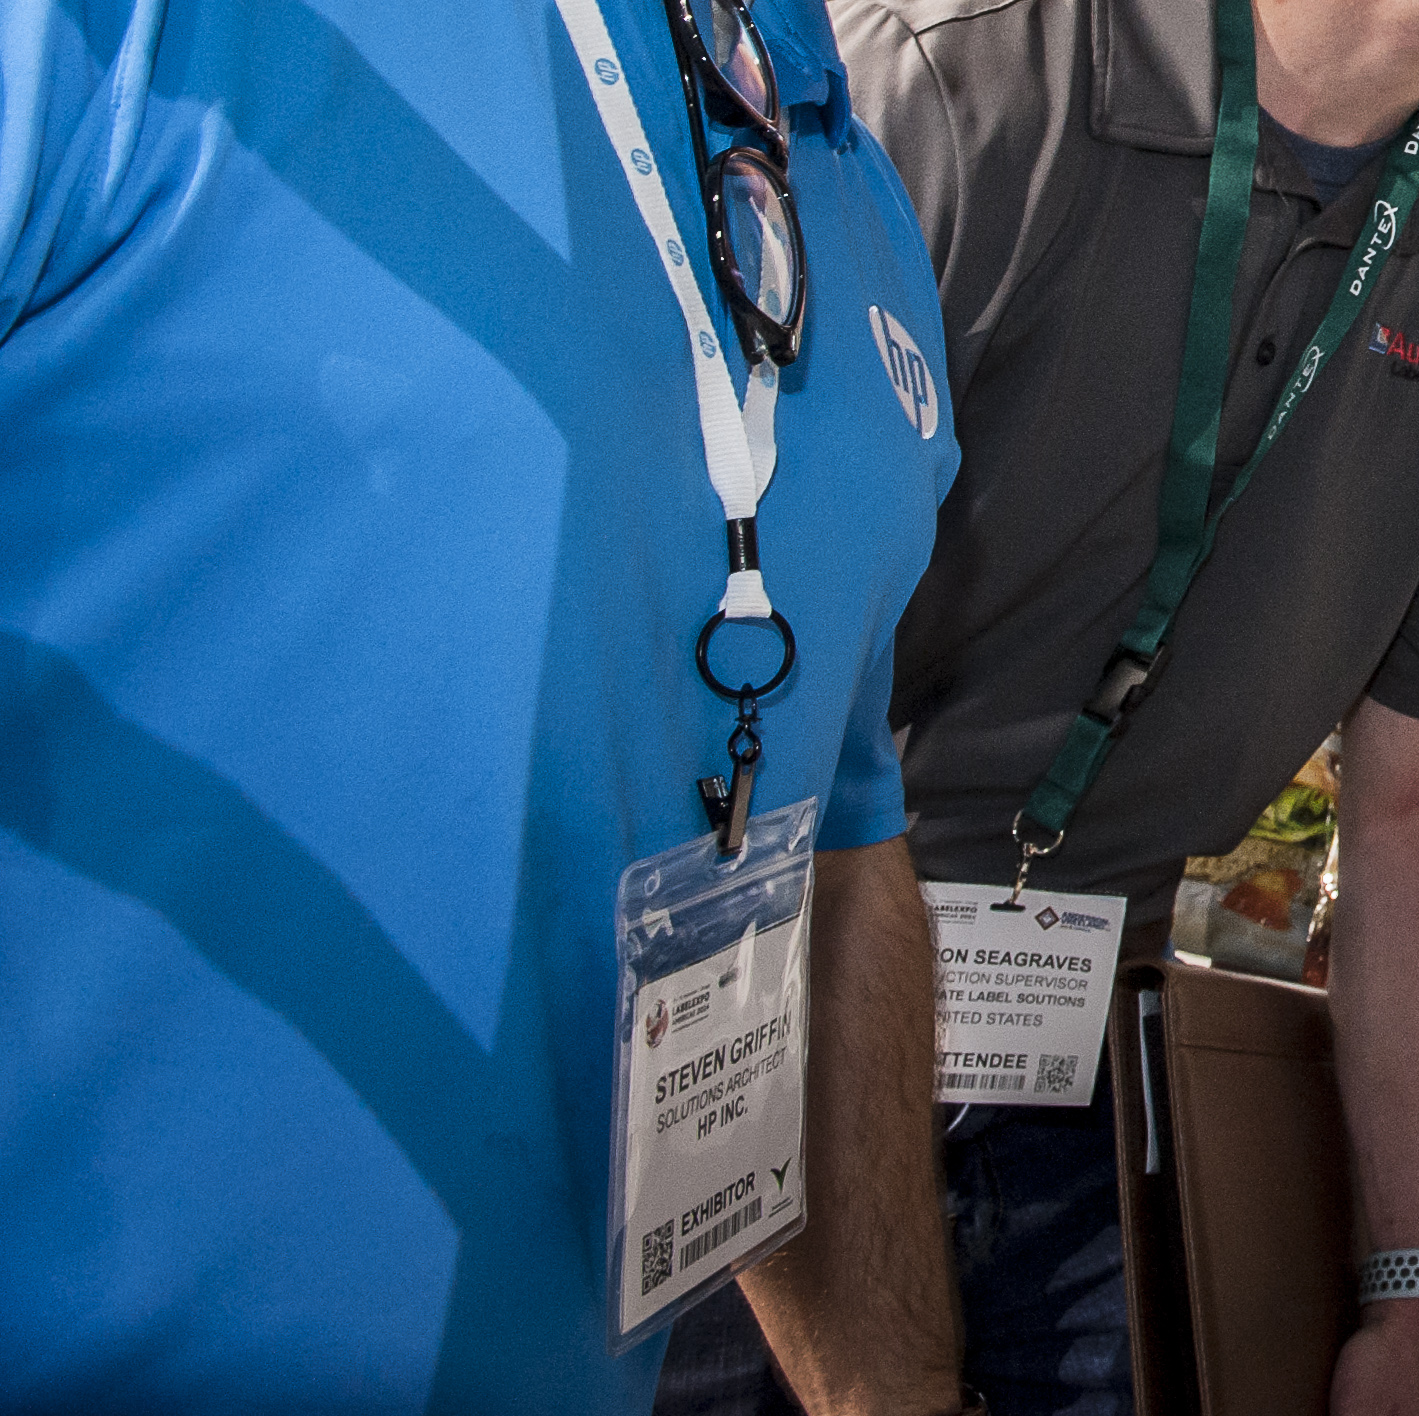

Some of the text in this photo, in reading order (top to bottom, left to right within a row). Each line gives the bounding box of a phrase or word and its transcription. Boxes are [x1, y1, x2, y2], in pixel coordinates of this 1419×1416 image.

[1349, 200, 1398, 296] DANTEX
[871, 303, 932, 439] hp
[1267, 346, 1324, 440] DANTEX
[973, 948, 1093, 974] SEAGRAVES
[994, 973, 1089, 991] SUPERVISOR
[968, 990, 1012, 1003] LABEL
[1016, 993, 1086, 1008] SOUTIONS
[986, 1012, 1044, 1028] STATES
[655, 1010, 792, 1105] STEVEN GRIFFIN
[940, 1051, 1029, 1070] TTENDEE
[657, 1046, 787, 1134] SOLUTIONS ARCHITECT
[697, 1095, 749, 1140] HP INC.
[680, 1171, 756, 1237] EXHIBITOR
